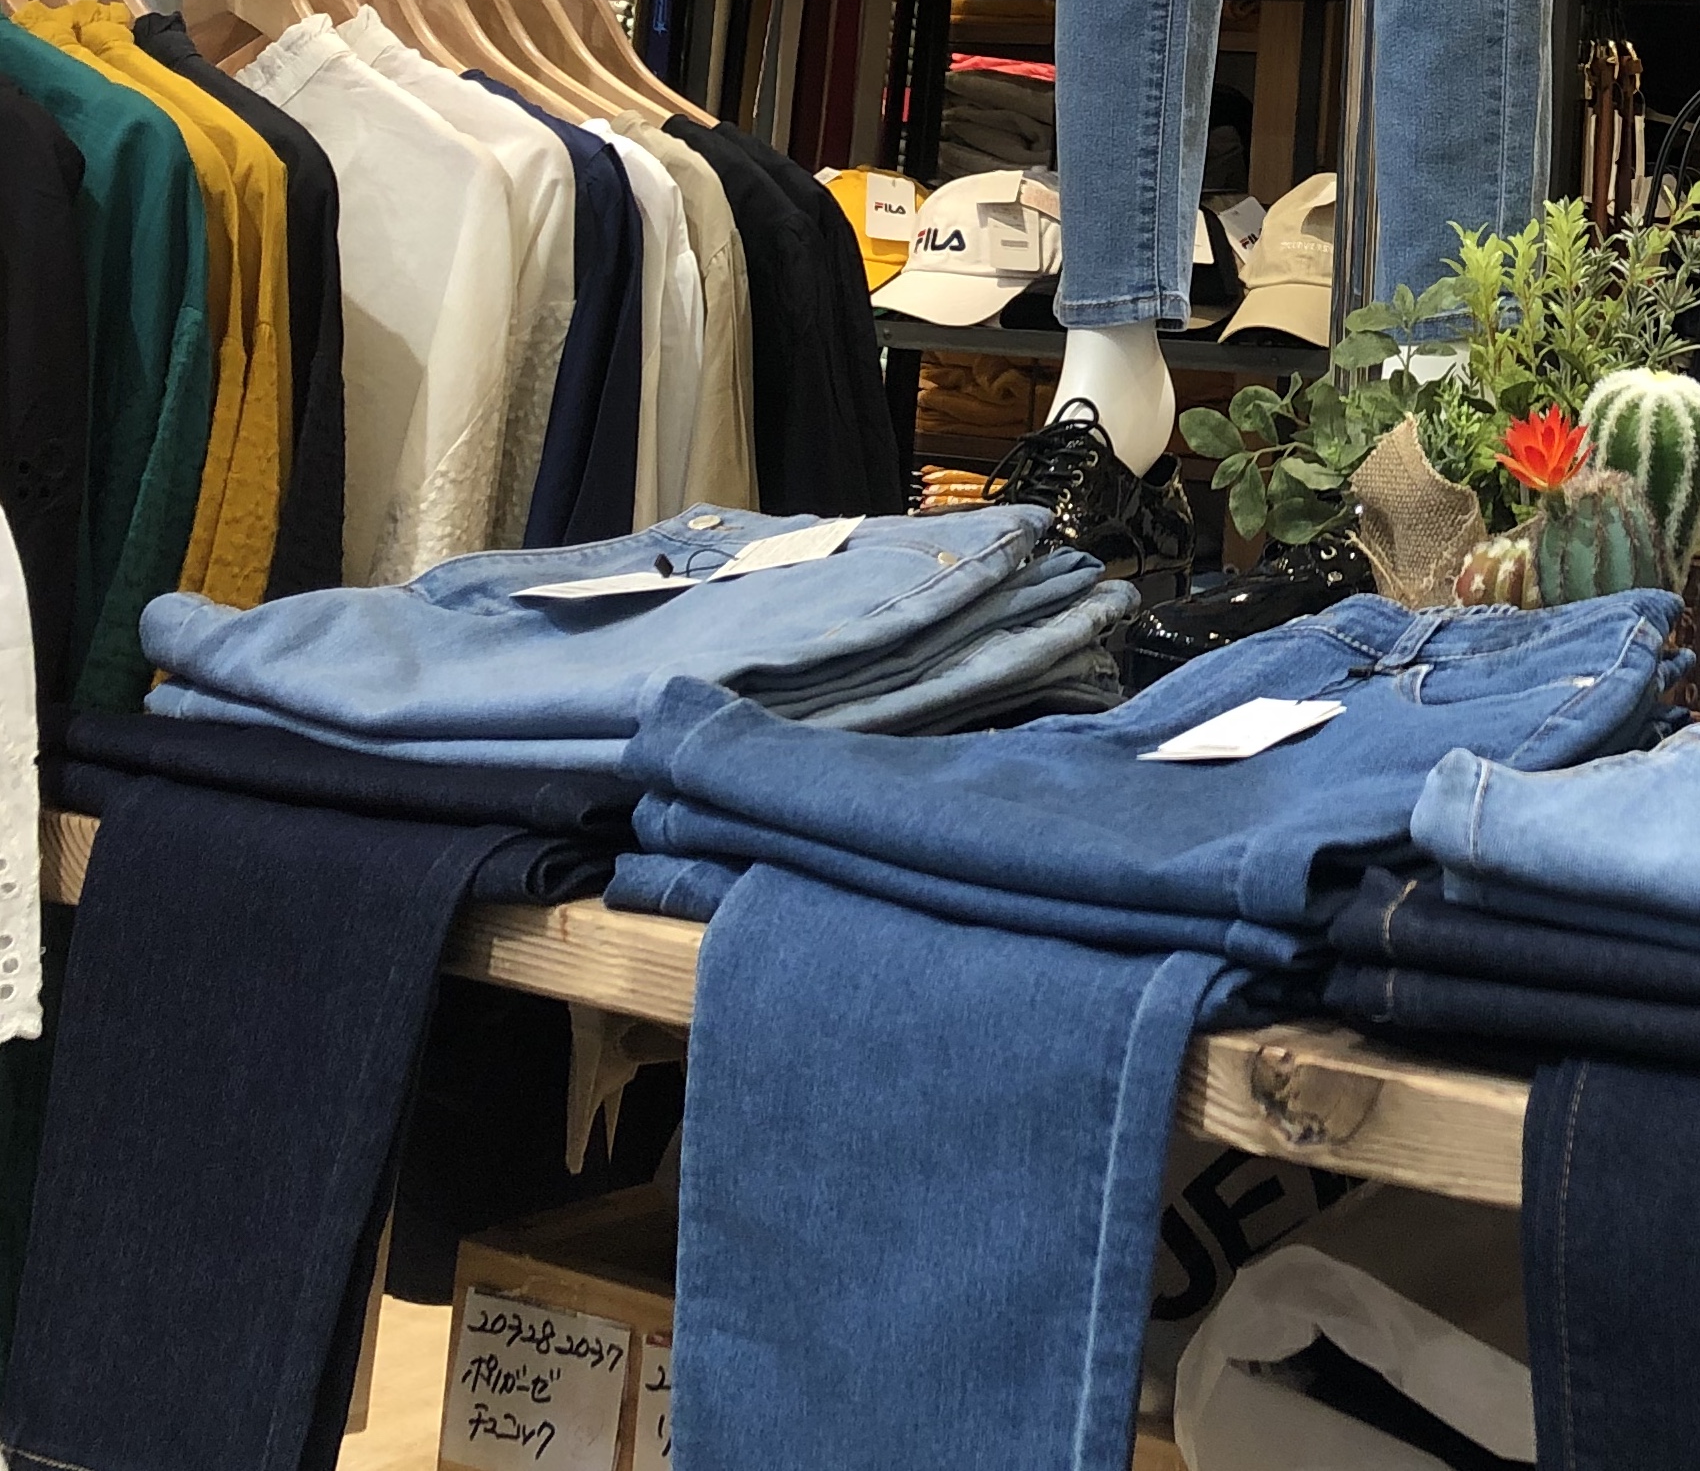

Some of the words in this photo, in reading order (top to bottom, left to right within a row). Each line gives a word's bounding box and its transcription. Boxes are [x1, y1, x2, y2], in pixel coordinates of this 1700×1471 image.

[874, 201, 907, 215] FILA
[913, 227, 967, 254] FILA
[1239, 227, 1263, 250] FIL
